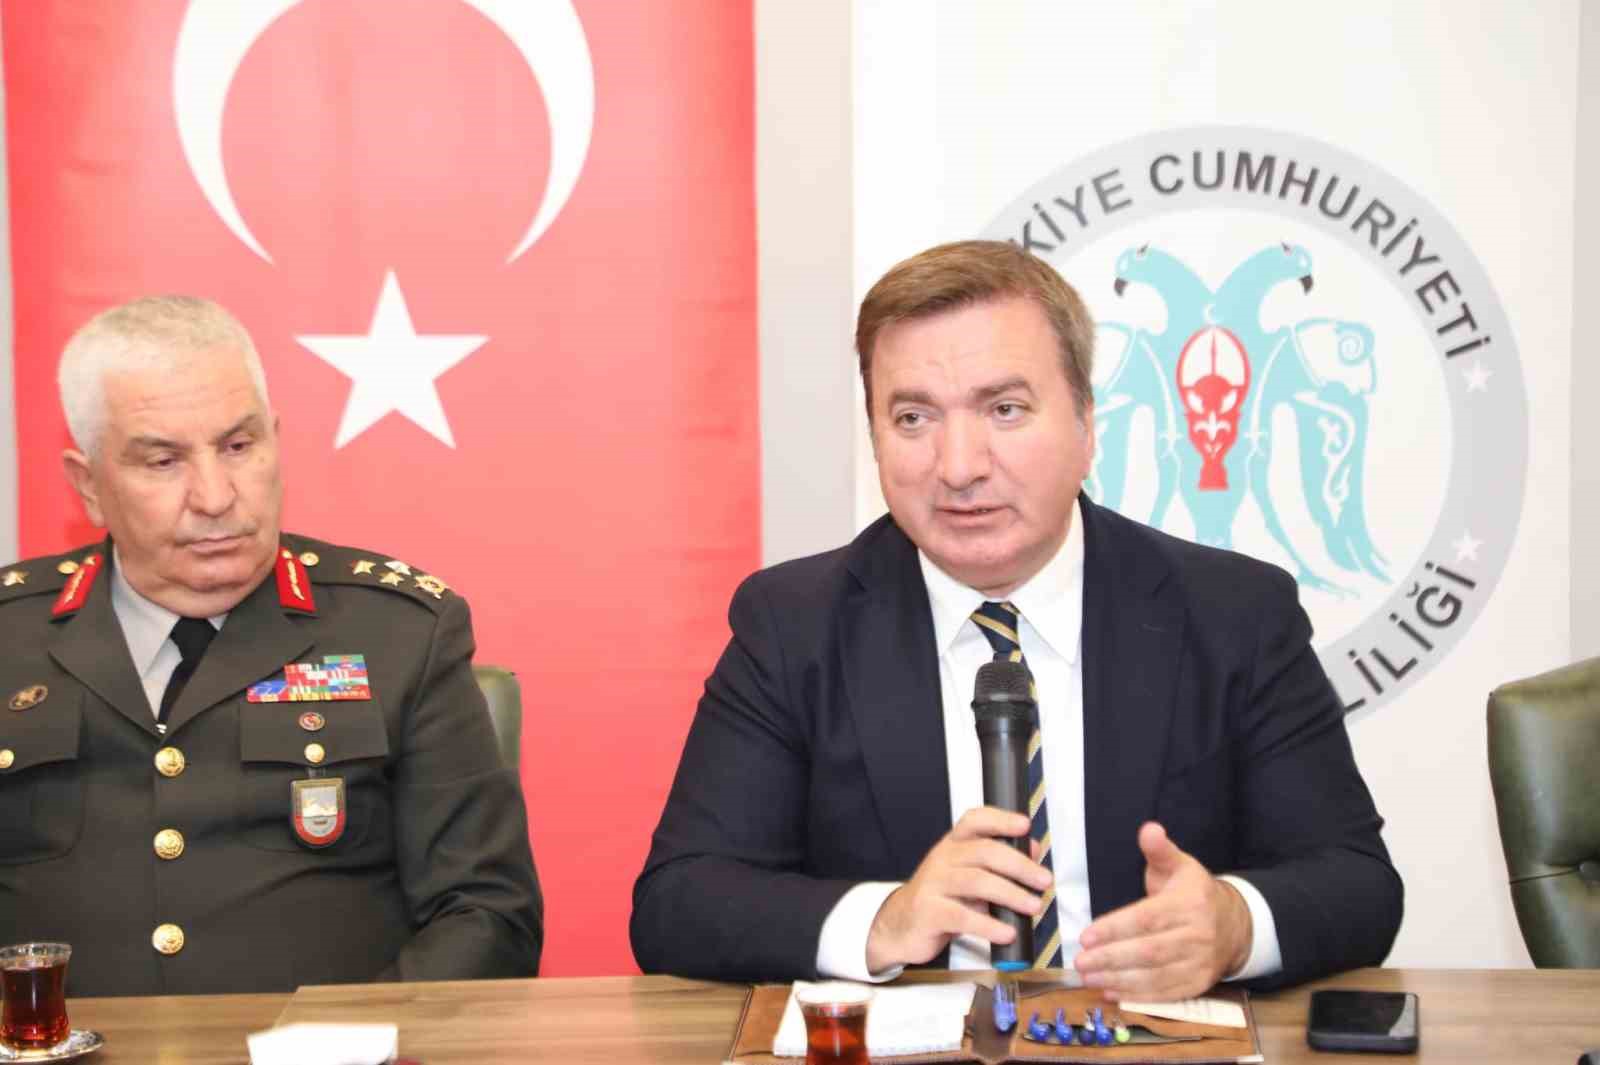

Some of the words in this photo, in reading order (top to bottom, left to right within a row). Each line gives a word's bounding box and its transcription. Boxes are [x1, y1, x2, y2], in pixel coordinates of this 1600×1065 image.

[1008, 168, 1133, 254] KİYE
[1149, 151, 1491, 360] CUMHURİYETİ
[1344, 562, 1476, 713] İLİĞİ
